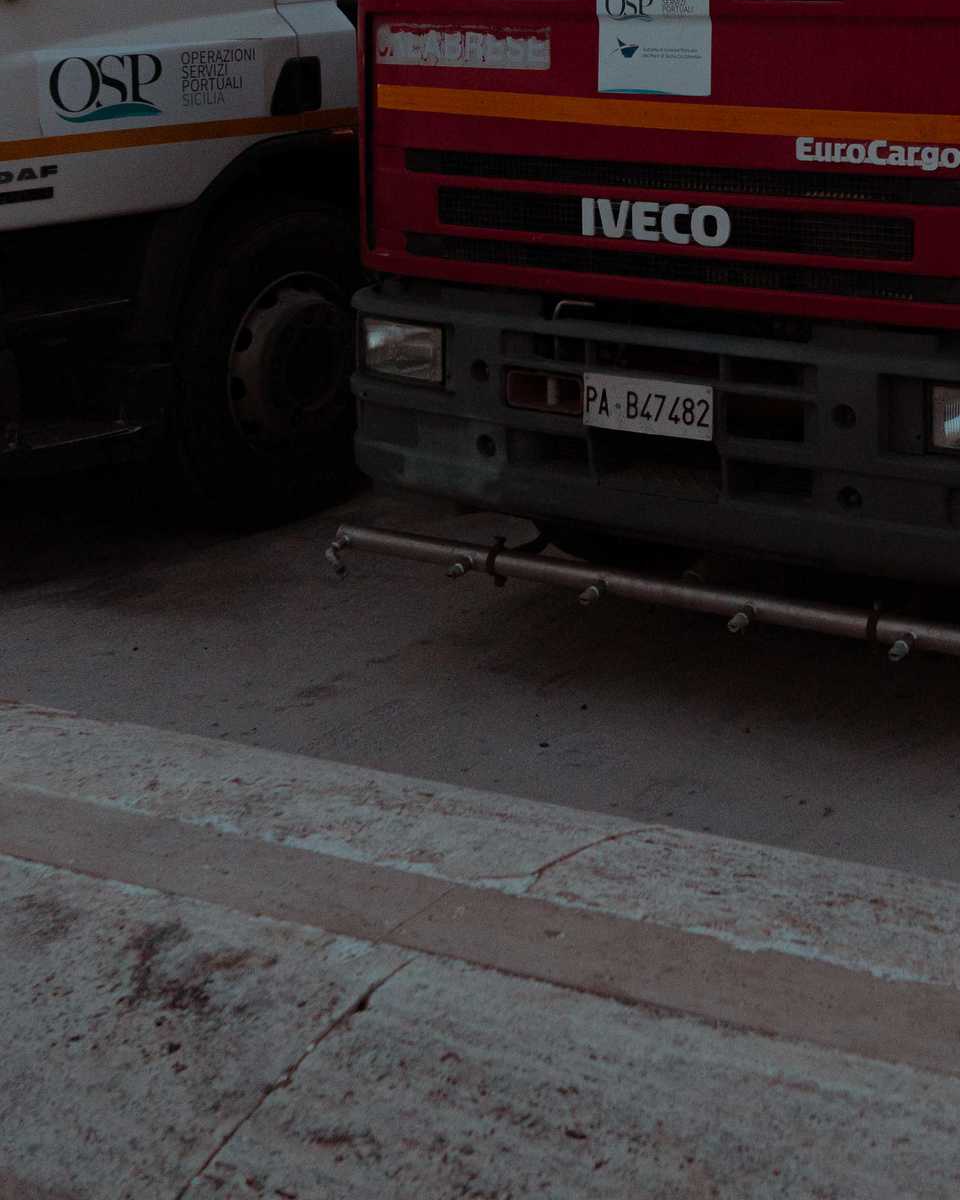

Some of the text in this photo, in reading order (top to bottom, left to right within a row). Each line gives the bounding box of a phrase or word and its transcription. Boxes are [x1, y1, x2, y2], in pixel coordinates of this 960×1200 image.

[181, 47, 256, 65] OPERAZIONI
[181, 63, 228, 80] SERVIZI
[50, 53, 162, 113] OSP
[181, 76, 243, 93] PORTUALI
[182, 91, 226, 107] SICILIA
[580, 197, 732, 248] IVECO
[585, 385, 710, 428] PA B47482
